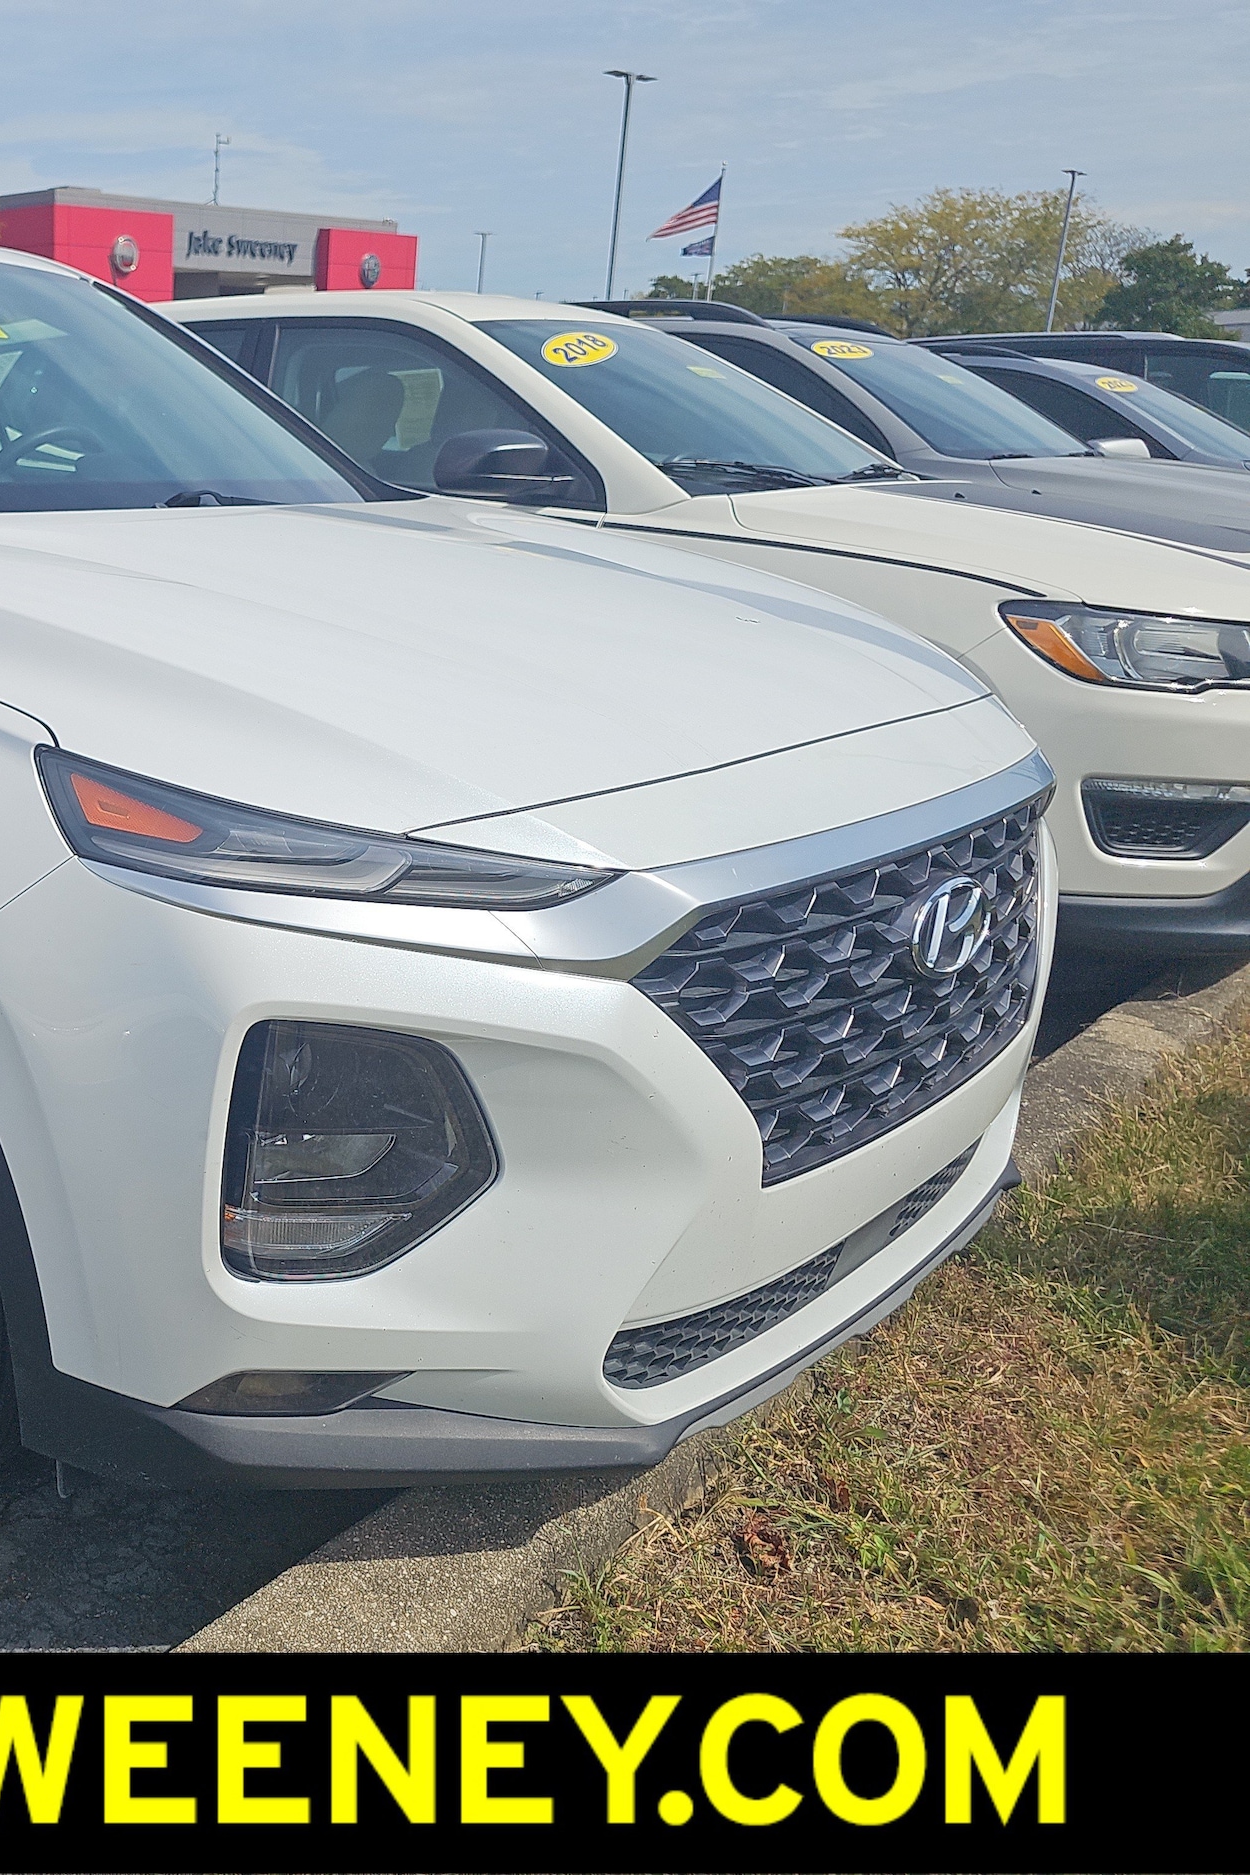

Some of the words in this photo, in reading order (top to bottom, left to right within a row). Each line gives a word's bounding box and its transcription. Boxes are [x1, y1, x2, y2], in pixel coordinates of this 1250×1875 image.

[186, 230, 223, 260] Jake
[227, 234, 298, 268] Sweeney
[552, 334, 607, 363] 2018
